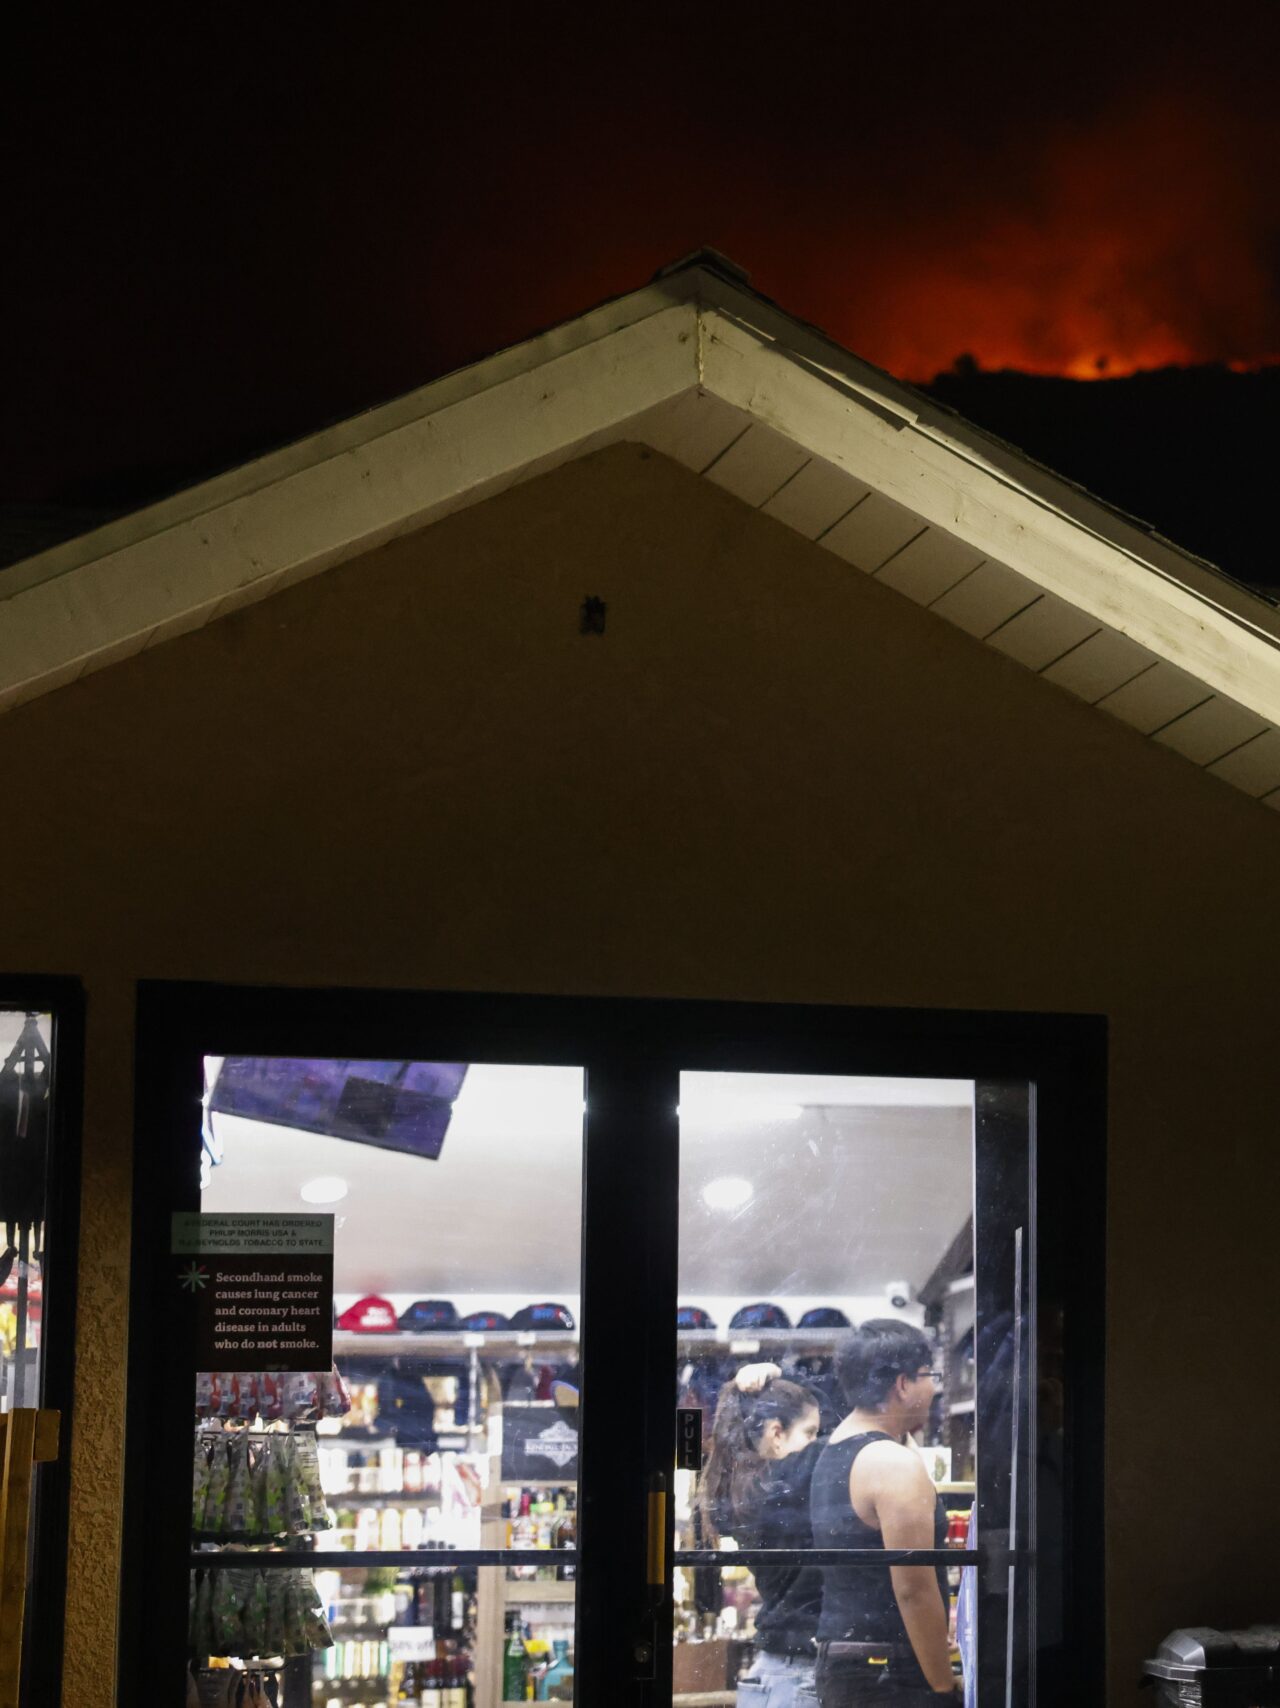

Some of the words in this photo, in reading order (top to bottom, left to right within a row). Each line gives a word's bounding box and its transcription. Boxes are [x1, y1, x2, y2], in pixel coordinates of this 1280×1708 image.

[231, 1219, 260, 1228] COURT
[263, 1219, 280, 1228] HAS
[282, 1219, 322, 1228] ORDERED
[209, 1229, 236, 1237] PHILIP
[237, 1229, 270, 1237] MORRIS
[243, 1239, 283, 1247] TOBACCO
[285, 1239, 296, 1247] TO
[215, 1272, 285, 1283] Secondhand
[287, 1272, 323, 1282] smoke
[215, 1290, 252, 1299] causes
[254, 1288, 280, 1301] lung
[281, 1290, 319, 1299] cancer
[215, 1305, 236, 1316] and
[238, 1307, 289, 1318] coronary
[291, 1305, 320, 1316] heart
[214, 1322, 255, 1332] disease
[257, 1322, 269, 1332] in
[271, 1322, 306, 1332] adults
[214, 1339, 239, 1349] who
[241, 1339, 255, 1349] do
[257, 1339, 278, 1349] not
[280, 1339, 319, 1349] smoke.
[684, 1413, 695, 1467] PULL
